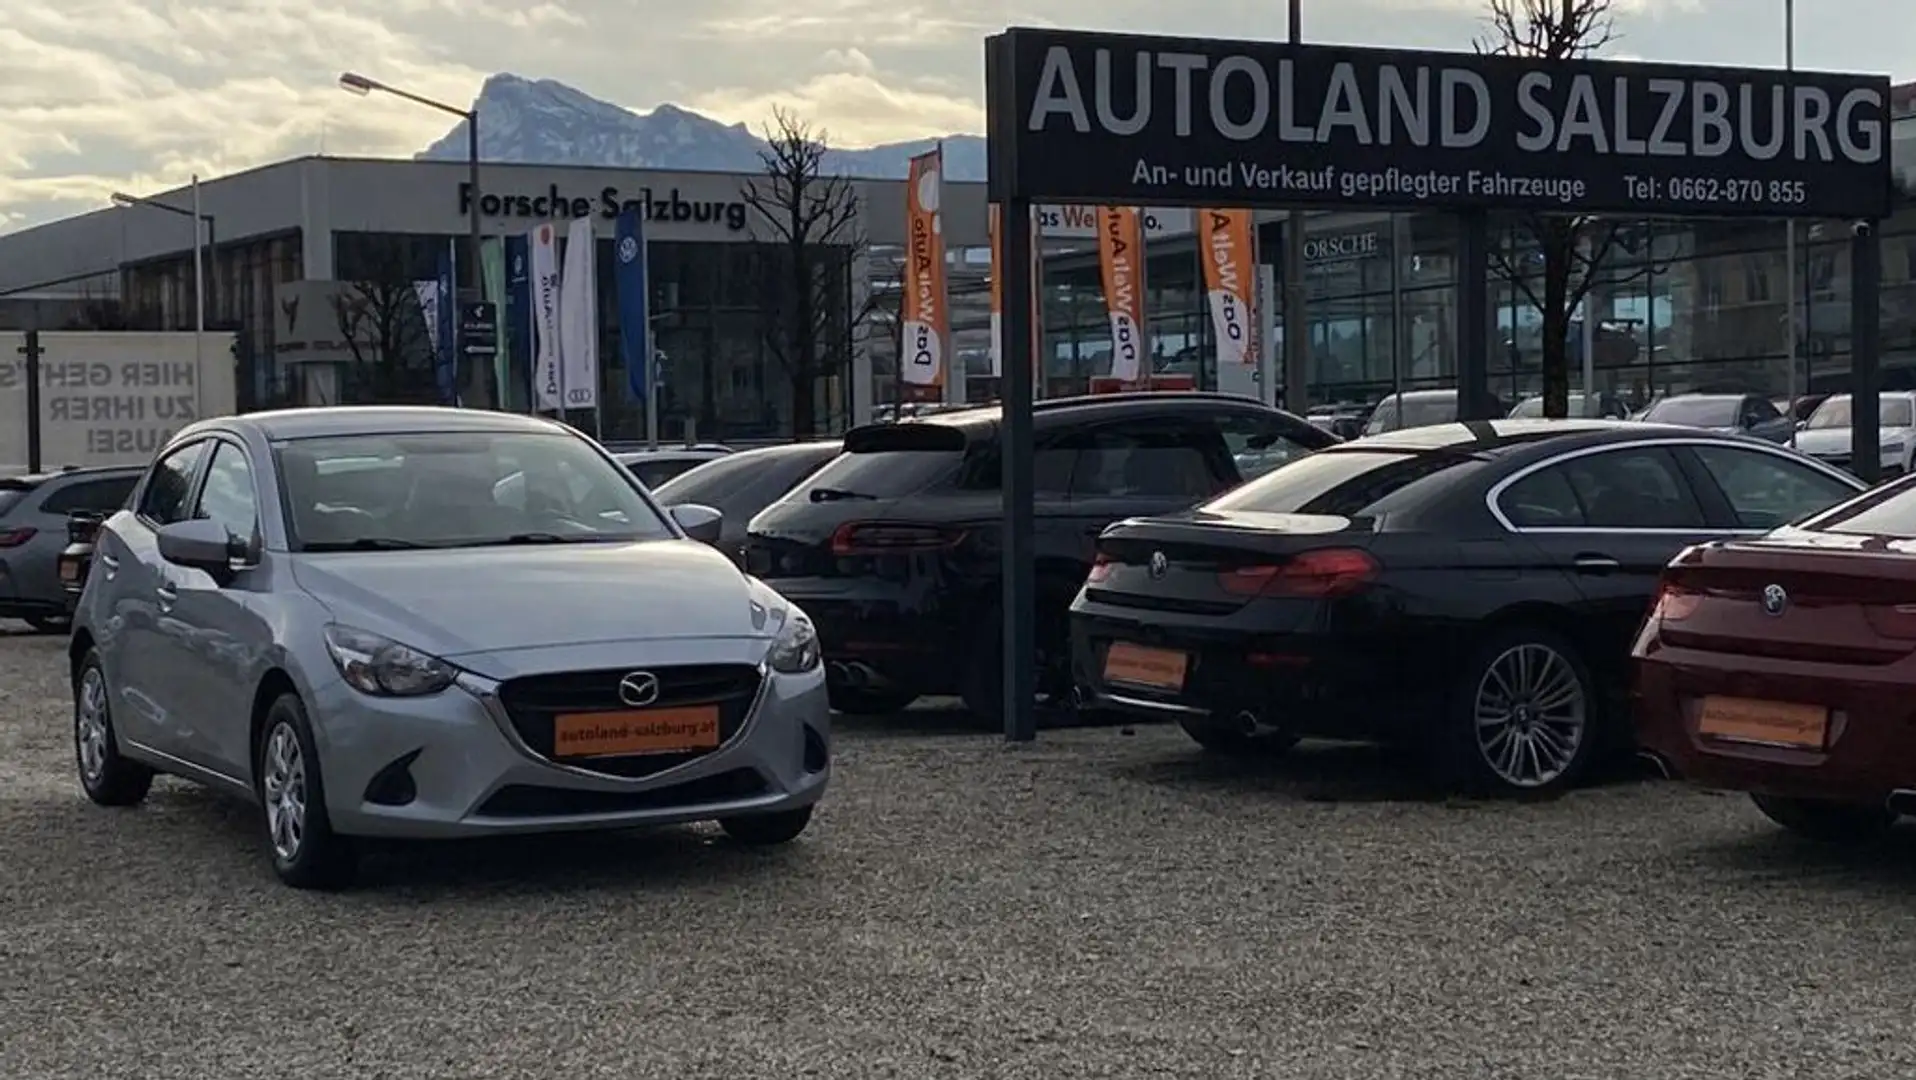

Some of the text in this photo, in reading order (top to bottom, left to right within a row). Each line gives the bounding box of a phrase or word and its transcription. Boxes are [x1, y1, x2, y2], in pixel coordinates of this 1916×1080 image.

[1028, 46, 1883, 164] AUTOLAND SALZBURG
[1132, 158, 1805, 203] An- und Verkauf gepflegter Fahrzeuge Tel: 0662-870 855
[458, 183, 747, 230] Porsche Salzburg
[1304, 232, 1378, 260] ORSCHE
[560, 719, 716, 743] autoland-salzburg.at
